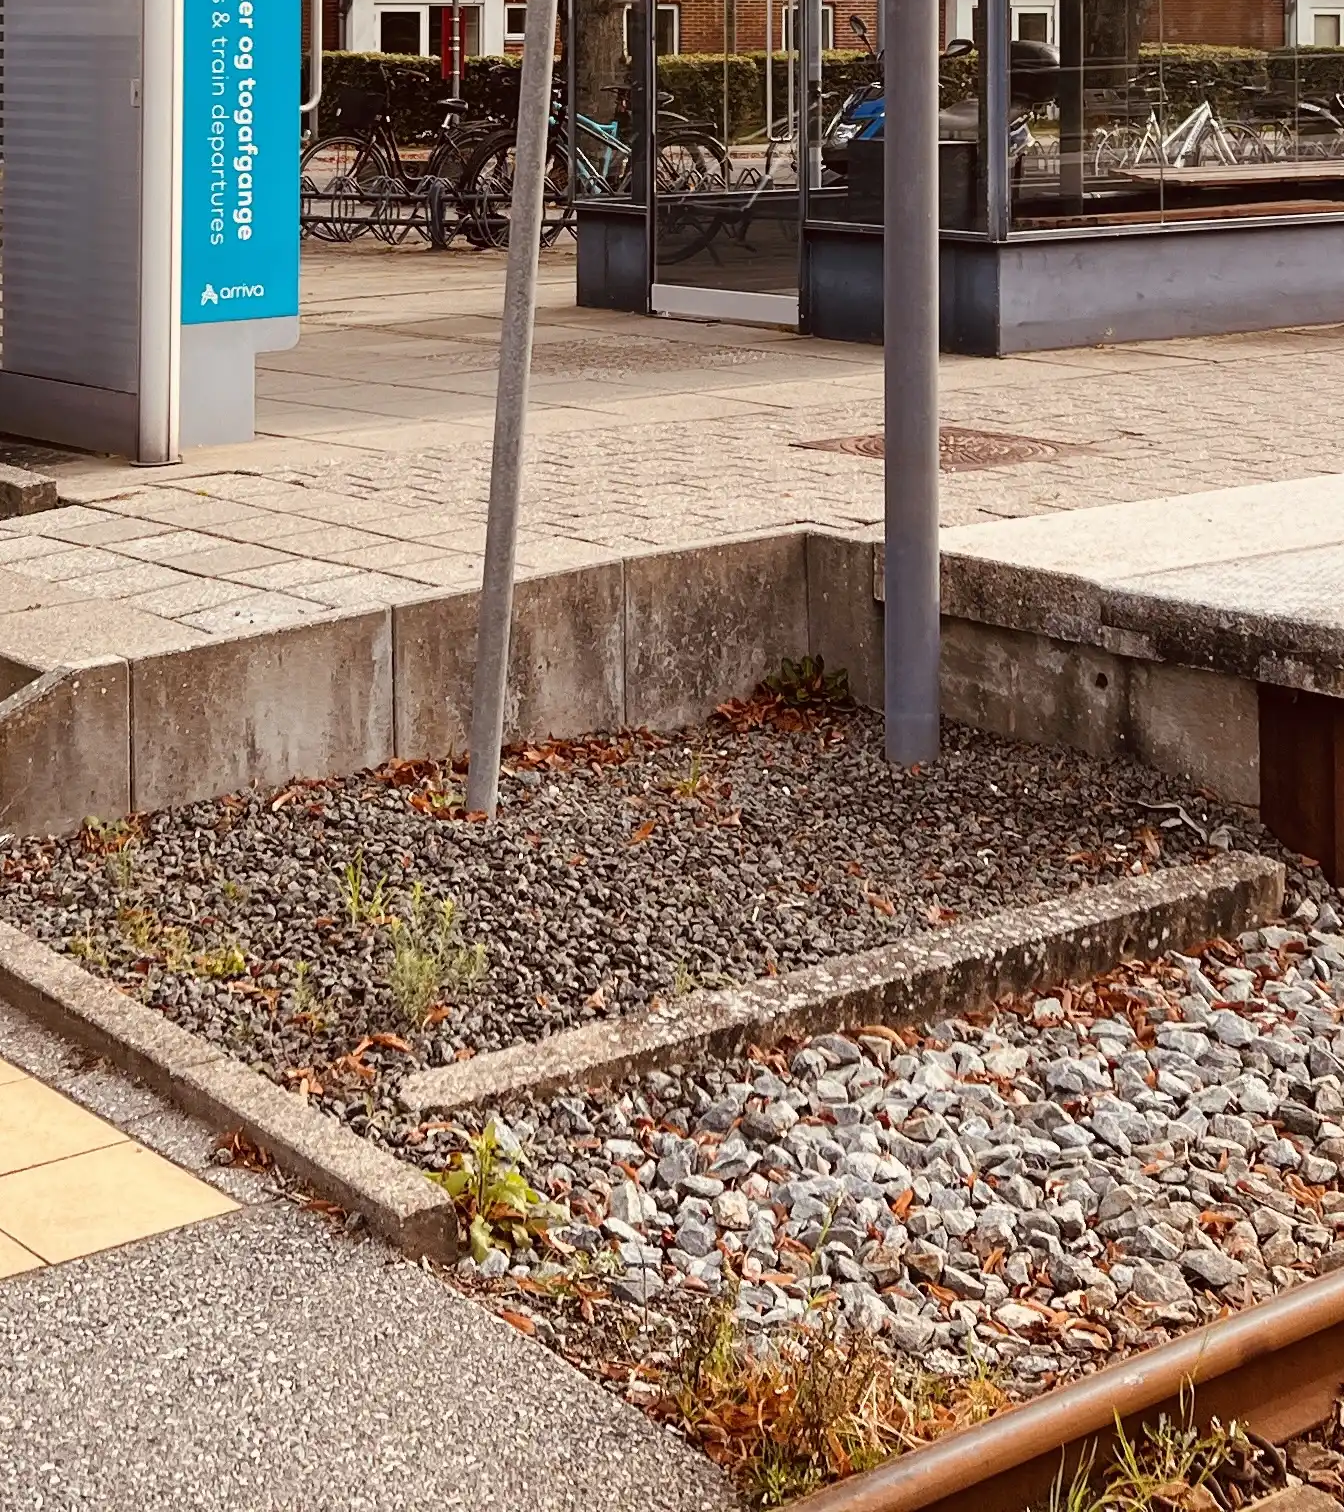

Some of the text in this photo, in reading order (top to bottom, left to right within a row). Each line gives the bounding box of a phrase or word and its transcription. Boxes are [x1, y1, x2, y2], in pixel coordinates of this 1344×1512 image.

[211, 11, 231, 29] &
[211, 36, 230, 96] train
[233, 36, 254, 70] og
[207, 104, 230, 245] departures
[233, 77, 259, 241] togafgange
[219, 283, 265, 299] arriva
